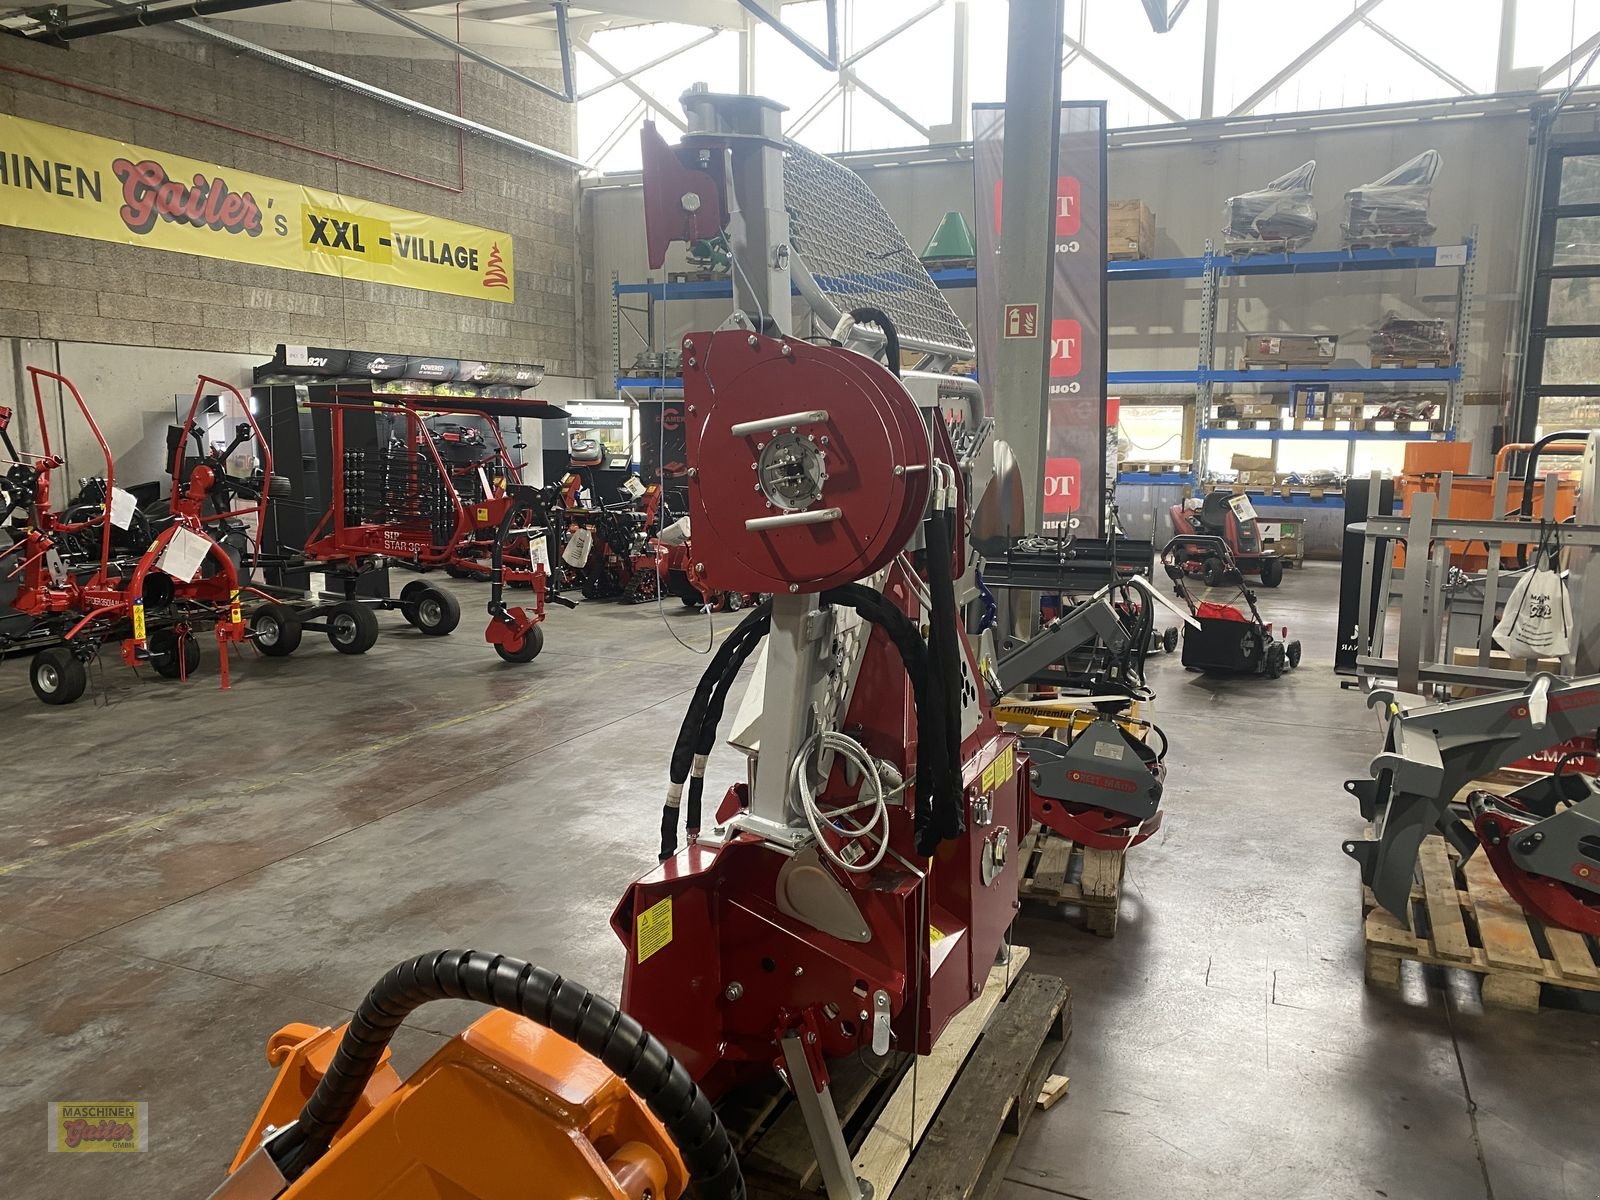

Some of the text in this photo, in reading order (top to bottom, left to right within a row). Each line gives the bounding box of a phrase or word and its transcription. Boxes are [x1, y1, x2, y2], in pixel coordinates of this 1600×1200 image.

[308, 214, 366, 253] XXL
[308, 357, 327, 367] 82V
[384, 531, 400, 540] SIP
[384, 540, 429, 552] STAR 36
